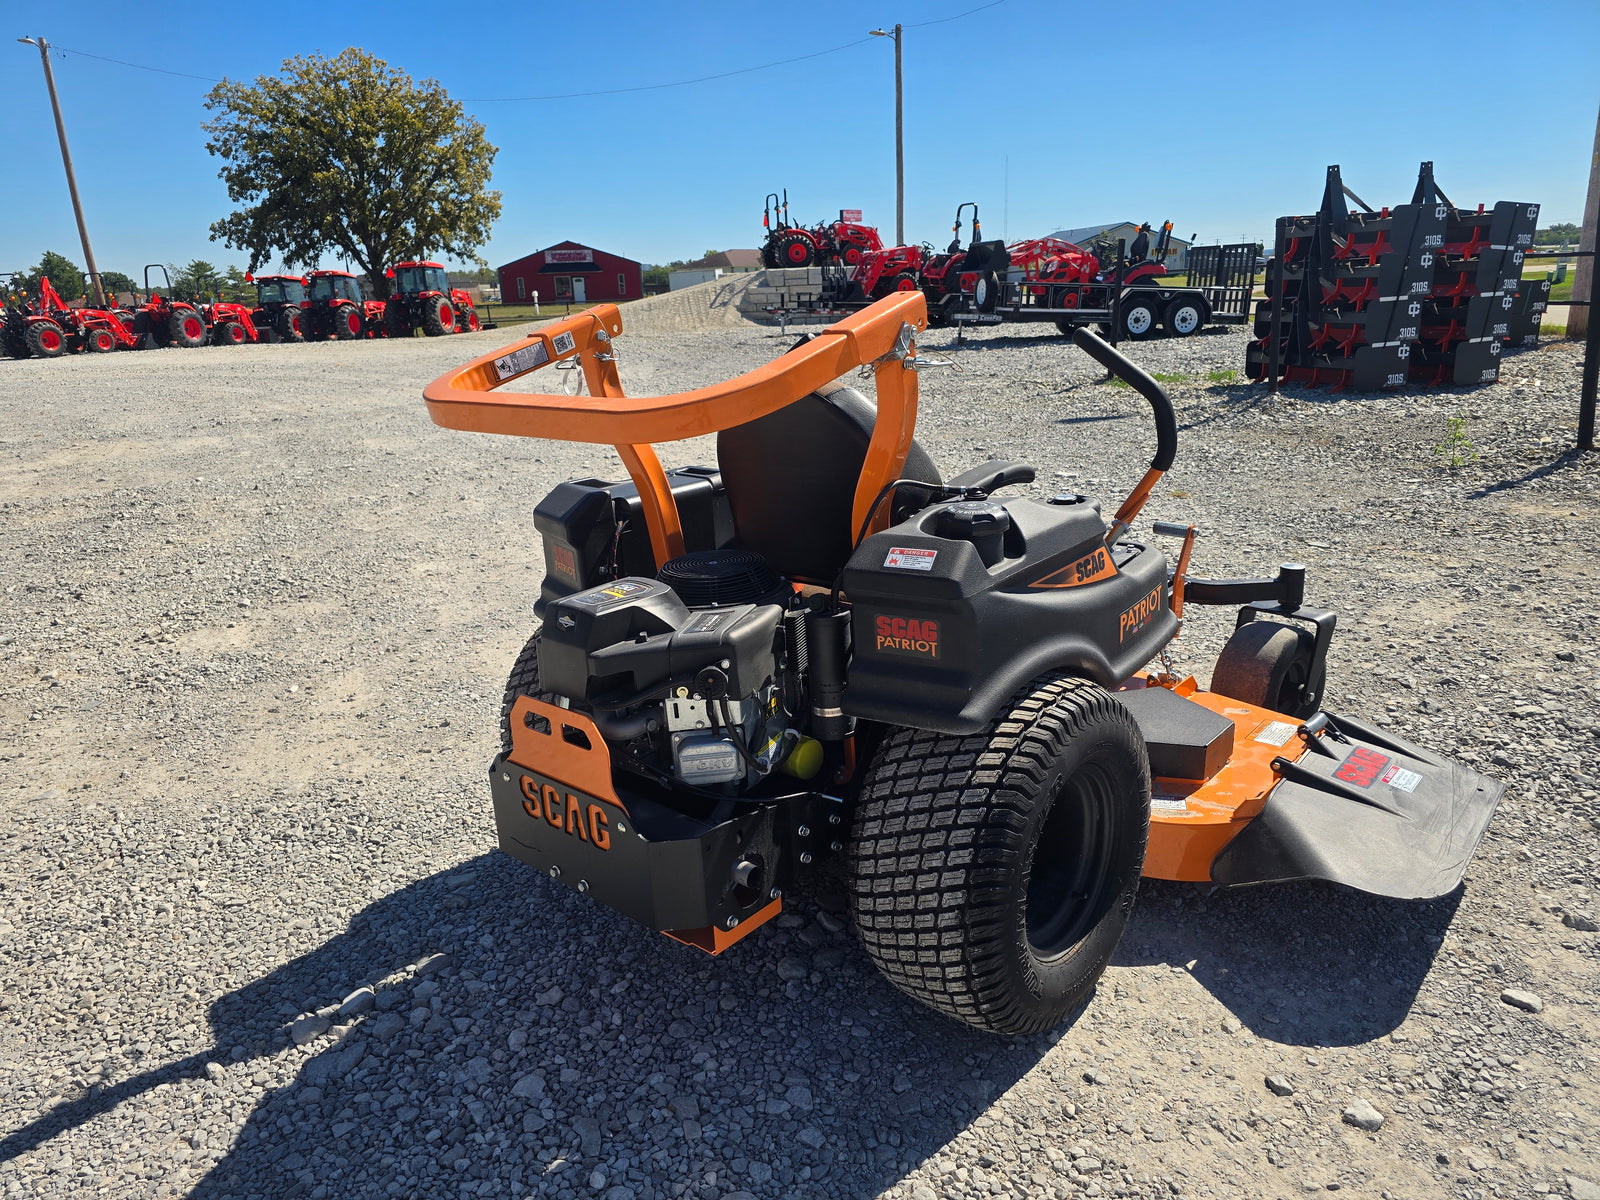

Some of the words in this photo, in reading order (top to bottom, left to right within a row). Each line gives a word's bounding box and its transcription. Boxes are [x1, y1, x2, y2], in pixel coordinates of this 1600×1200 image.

[1075, 551, 1106, 583] SCAG
[876, 615, 938, 642] SCAG
[1120, 585, 1162, 643] PATRIOT
[877, 635, 938, 658] PATRIOT
[1336, 748, 1389, 787] SCAG
[520, 774, 611, 851] SCAG
